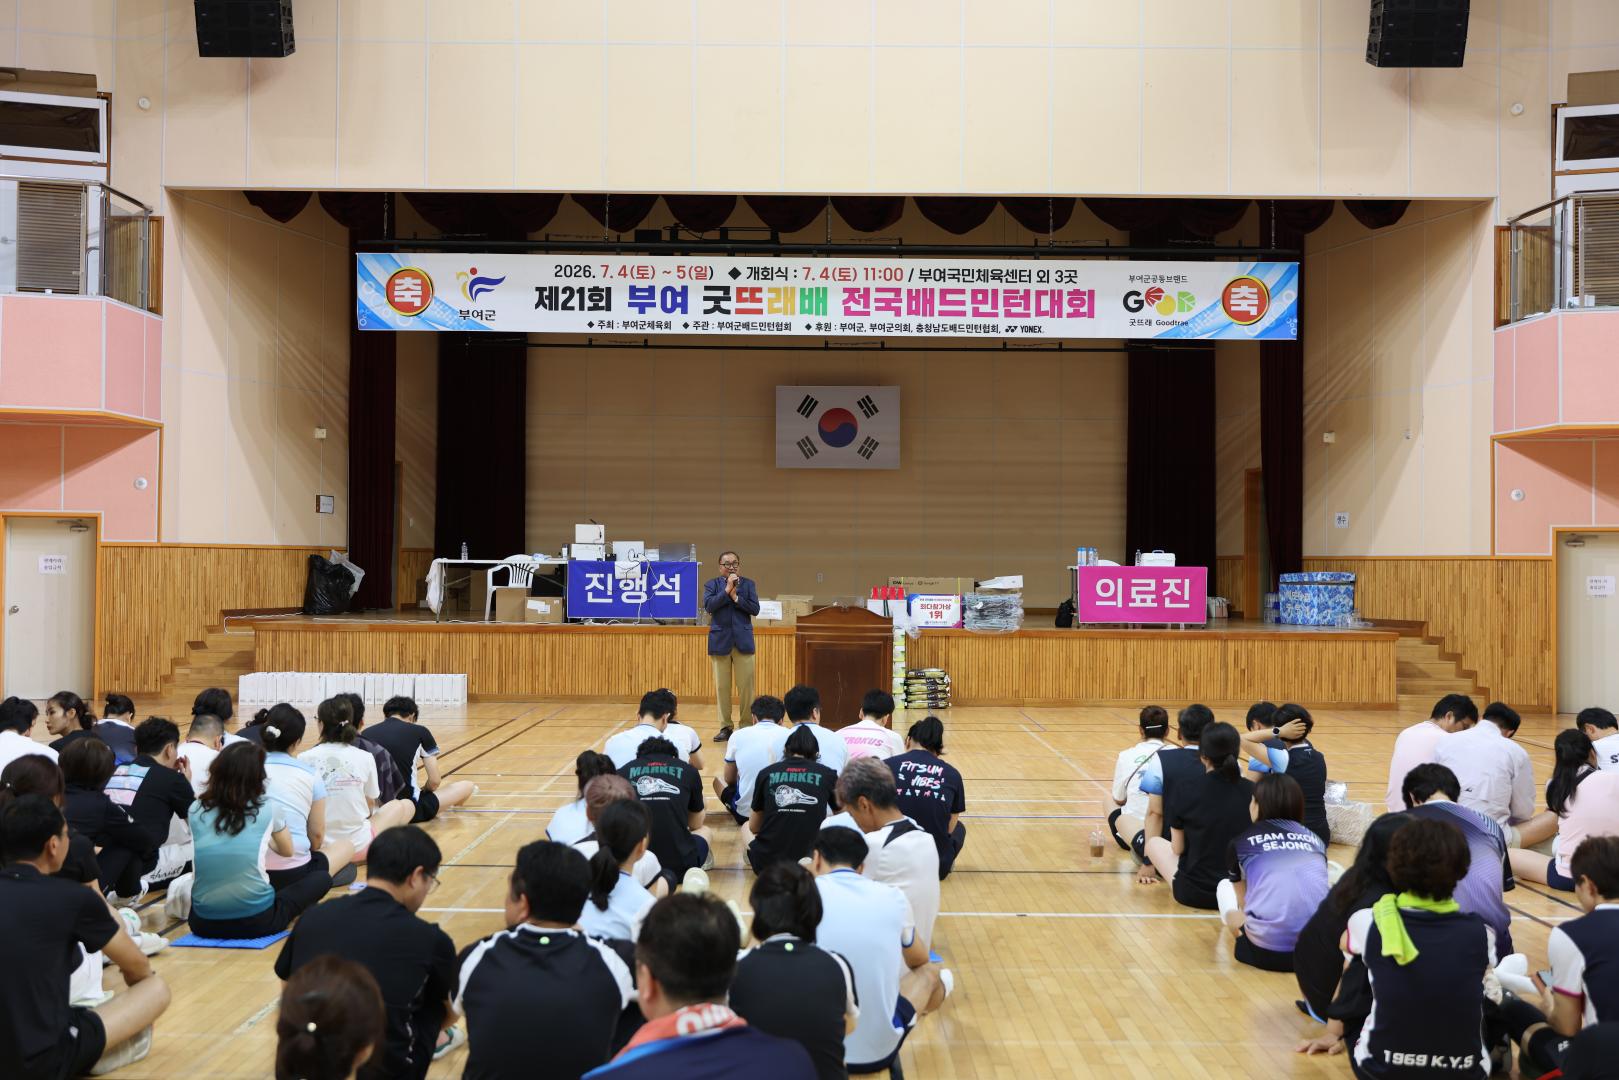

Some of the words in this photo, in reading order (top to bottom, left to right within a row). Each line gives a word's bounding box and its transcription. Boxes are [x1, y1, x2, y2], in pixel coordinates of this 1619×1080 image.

[554, 264, 596, 278] 2026.
[676, 265, 714, 280] 5(일)
[746, 266, 788, 281] 개회식
[863, 267, 904, 282] 11:00
[918, 268, 1032, 284] 부여국민체육센터
[1036, 269, 1050, 284] 외
[1054, 269, 1078, 285] 3곳
[1128, 274, 1189, 284] 부여군공동브랜드
[393, 276, 423, 307] 축
[534, 285, 612, 312] 제21회
[627, 285, 689, 315] 부여
[702, 285, 828, 317] 굿뜨래배
[841, 287, 1096, 319] 전국배드민턴대회
[1229, 285, 1259, 316] 축
[458, 309, 497, 321] 부여군
[1128, 318, 1153, 327] 굿뜨래
[597, 320, 615, 330] 주최
[621, 320, 672, 331] 부여군체육회
[692, 321, 710, 331] 주관
[716, 321, 792, 332] 부여군배드민턴협회
[815, 322, 832, 332] 후원
[839, 322, 867, 333] 부여군,
[1020, 325, 1043, 334] YONEX
[584, 573, 681, 604] 진행석
[1095, 578, 1190, 608] 의료진
[928, 610, 943, 620] 1위
[629, 765, 684, 780] MARKET
[899, 760, 944, 777] FITSUM
[769, 771, 822, 787] MARKET
[911, 775, 942, 790] VIBES
[1247, 832, 1284, 846] TEAM
[1262, 841, 1314, 852] SEJONG
[1383, 1049, 1428, 1067] 1969
[1430, 1054, 1475, 1069] K.Y.S
